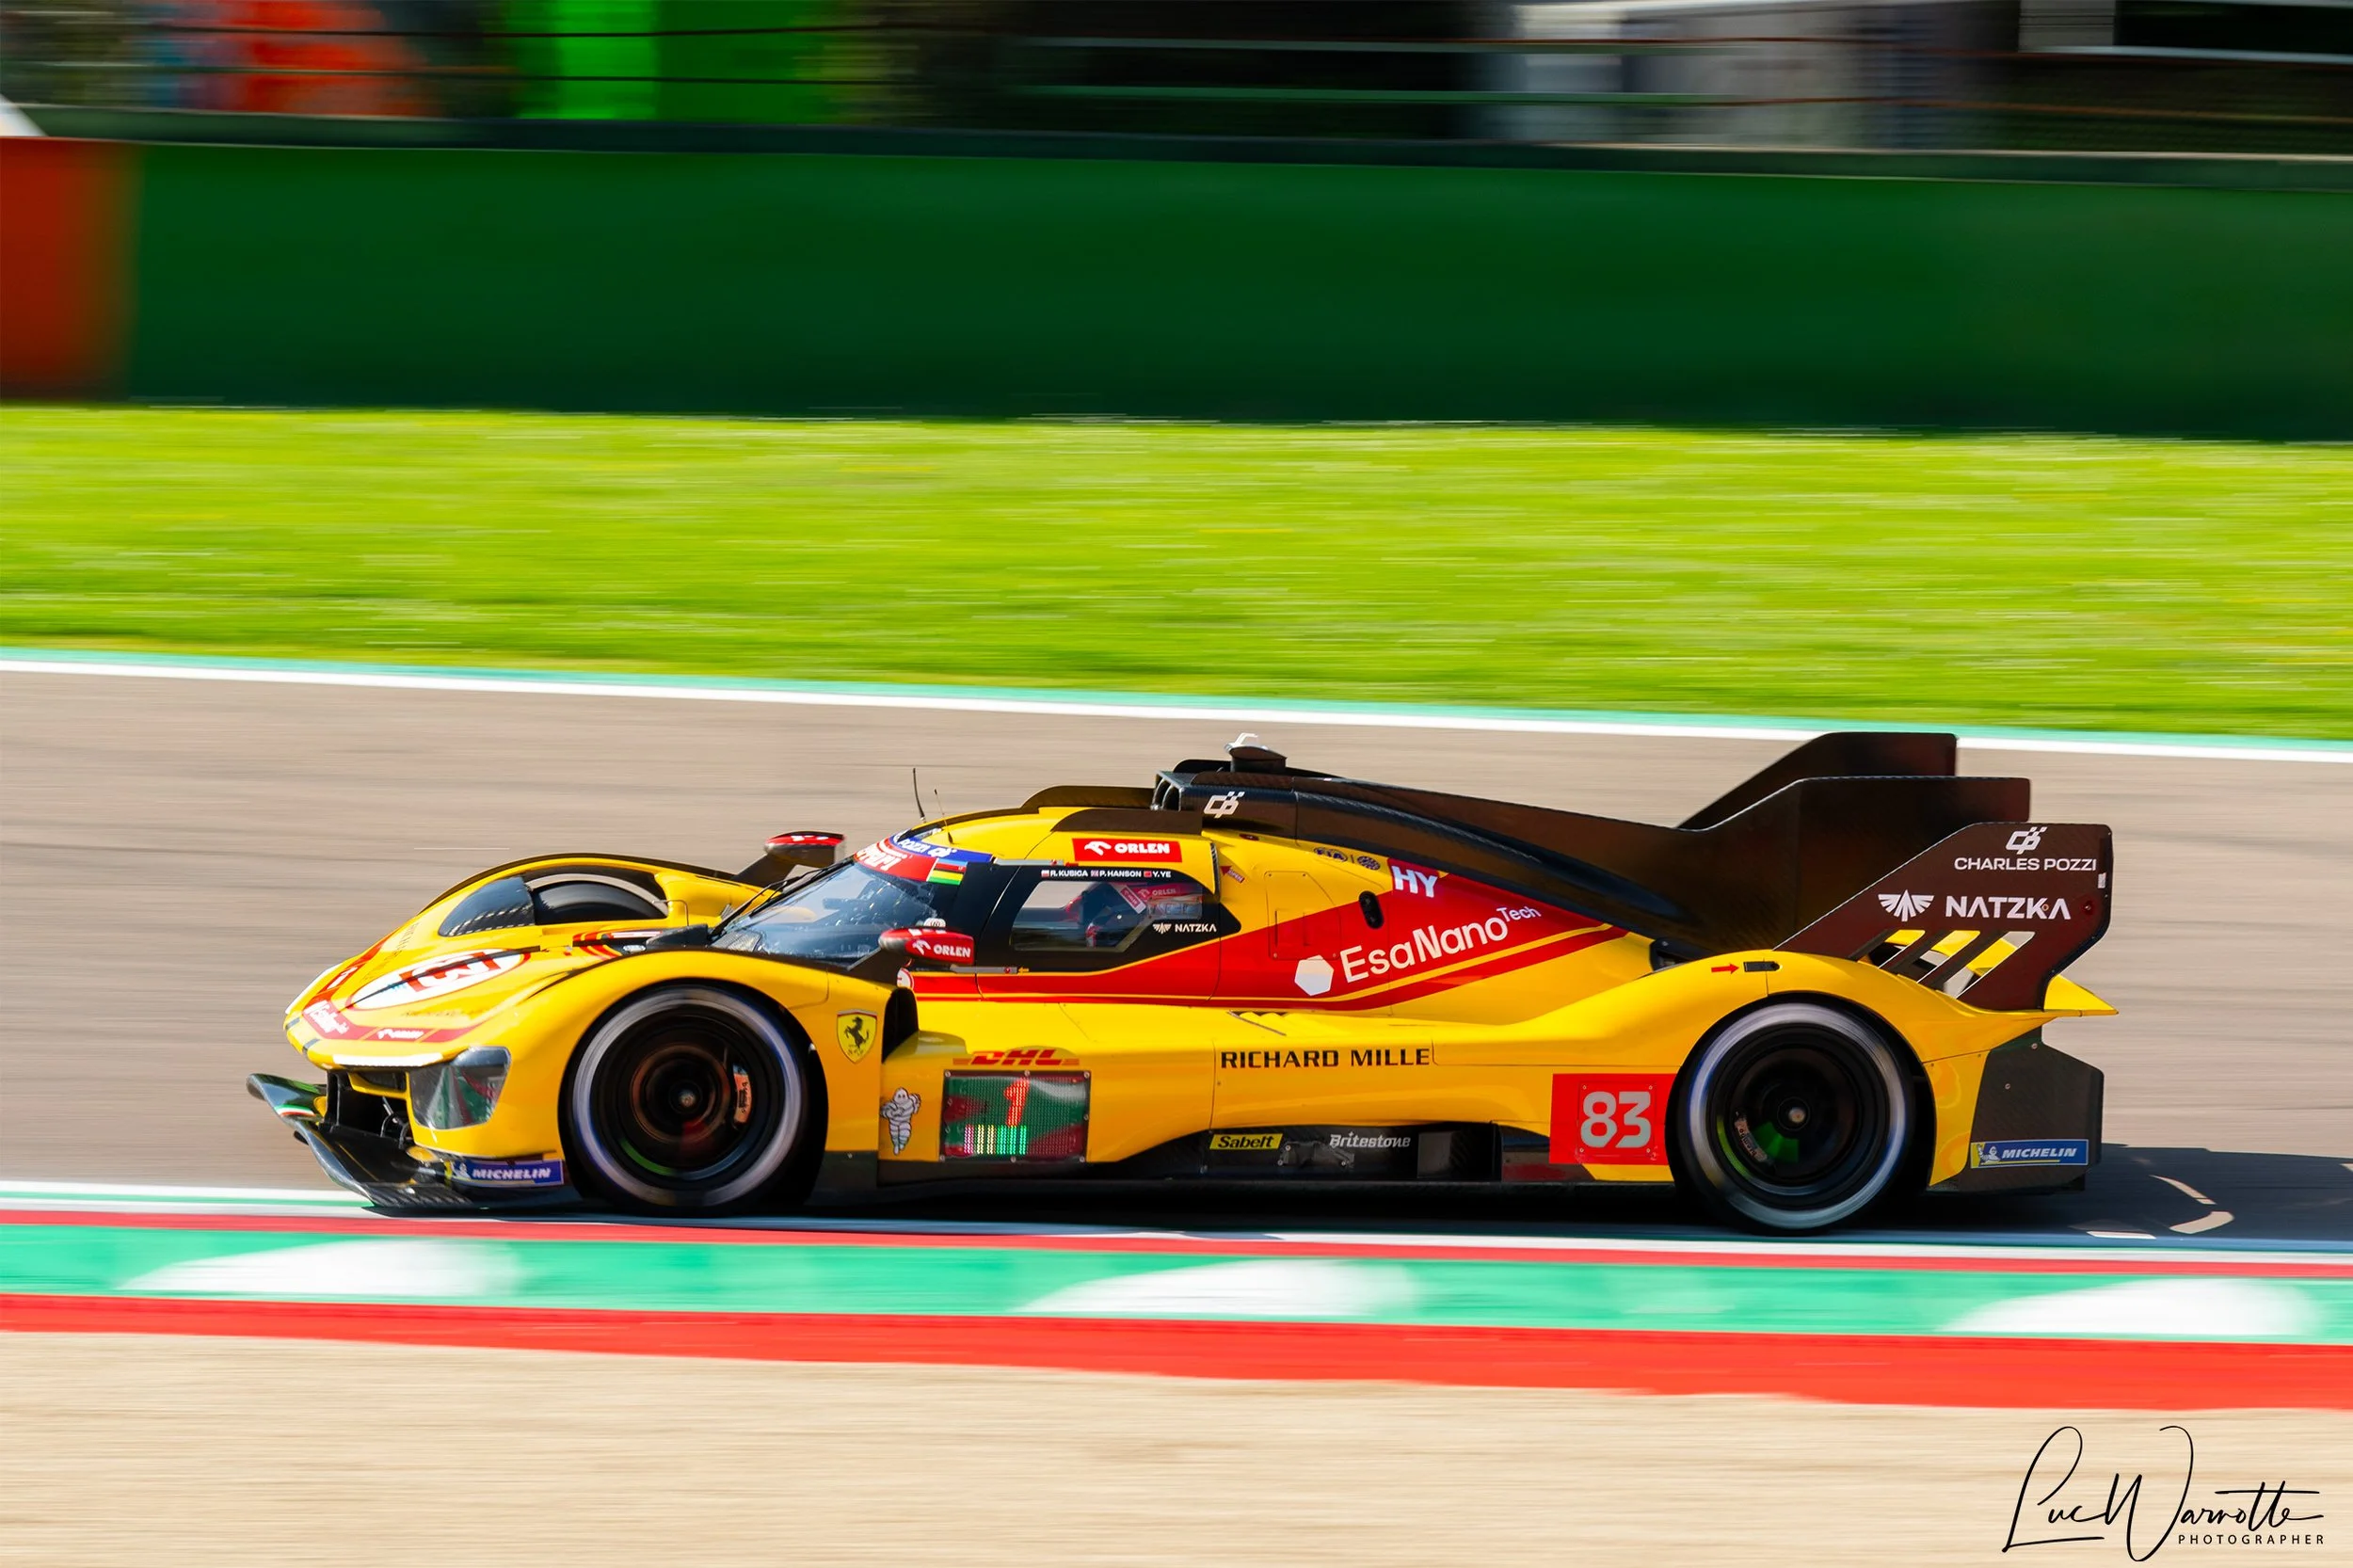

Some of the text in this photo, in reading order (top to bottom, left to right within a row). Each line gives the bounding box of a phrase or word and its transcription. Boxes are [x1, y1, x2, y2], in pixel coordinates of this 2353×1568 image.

[1114, 843, 1171, 855] ORLEN
[1954, 857, 2097, 871] CHARLES POZZI
[1391, 865, 1438, 898] HY
[1945, 895, 2072, 920] NATZKA
[1175, 923, 1217, 933] NATZKA
[934, 944, 971, 958] ORLEN
[970, 1049, 1064, 1065] DHL
[1221, 1048, 1430, 1069] RICHARD MILLE
[1003, 1077, 1031, 1127] 1
[1580, 1091, 1652, 1148] 83
[1218, 1135, 1273, 1148] Sabelt
[1329, 1131, 1411, 1148] Britestone
[2002, 1148, 2077, 1160] MICHELIN
[472, 1167, 551, 1180] MICHELIN
